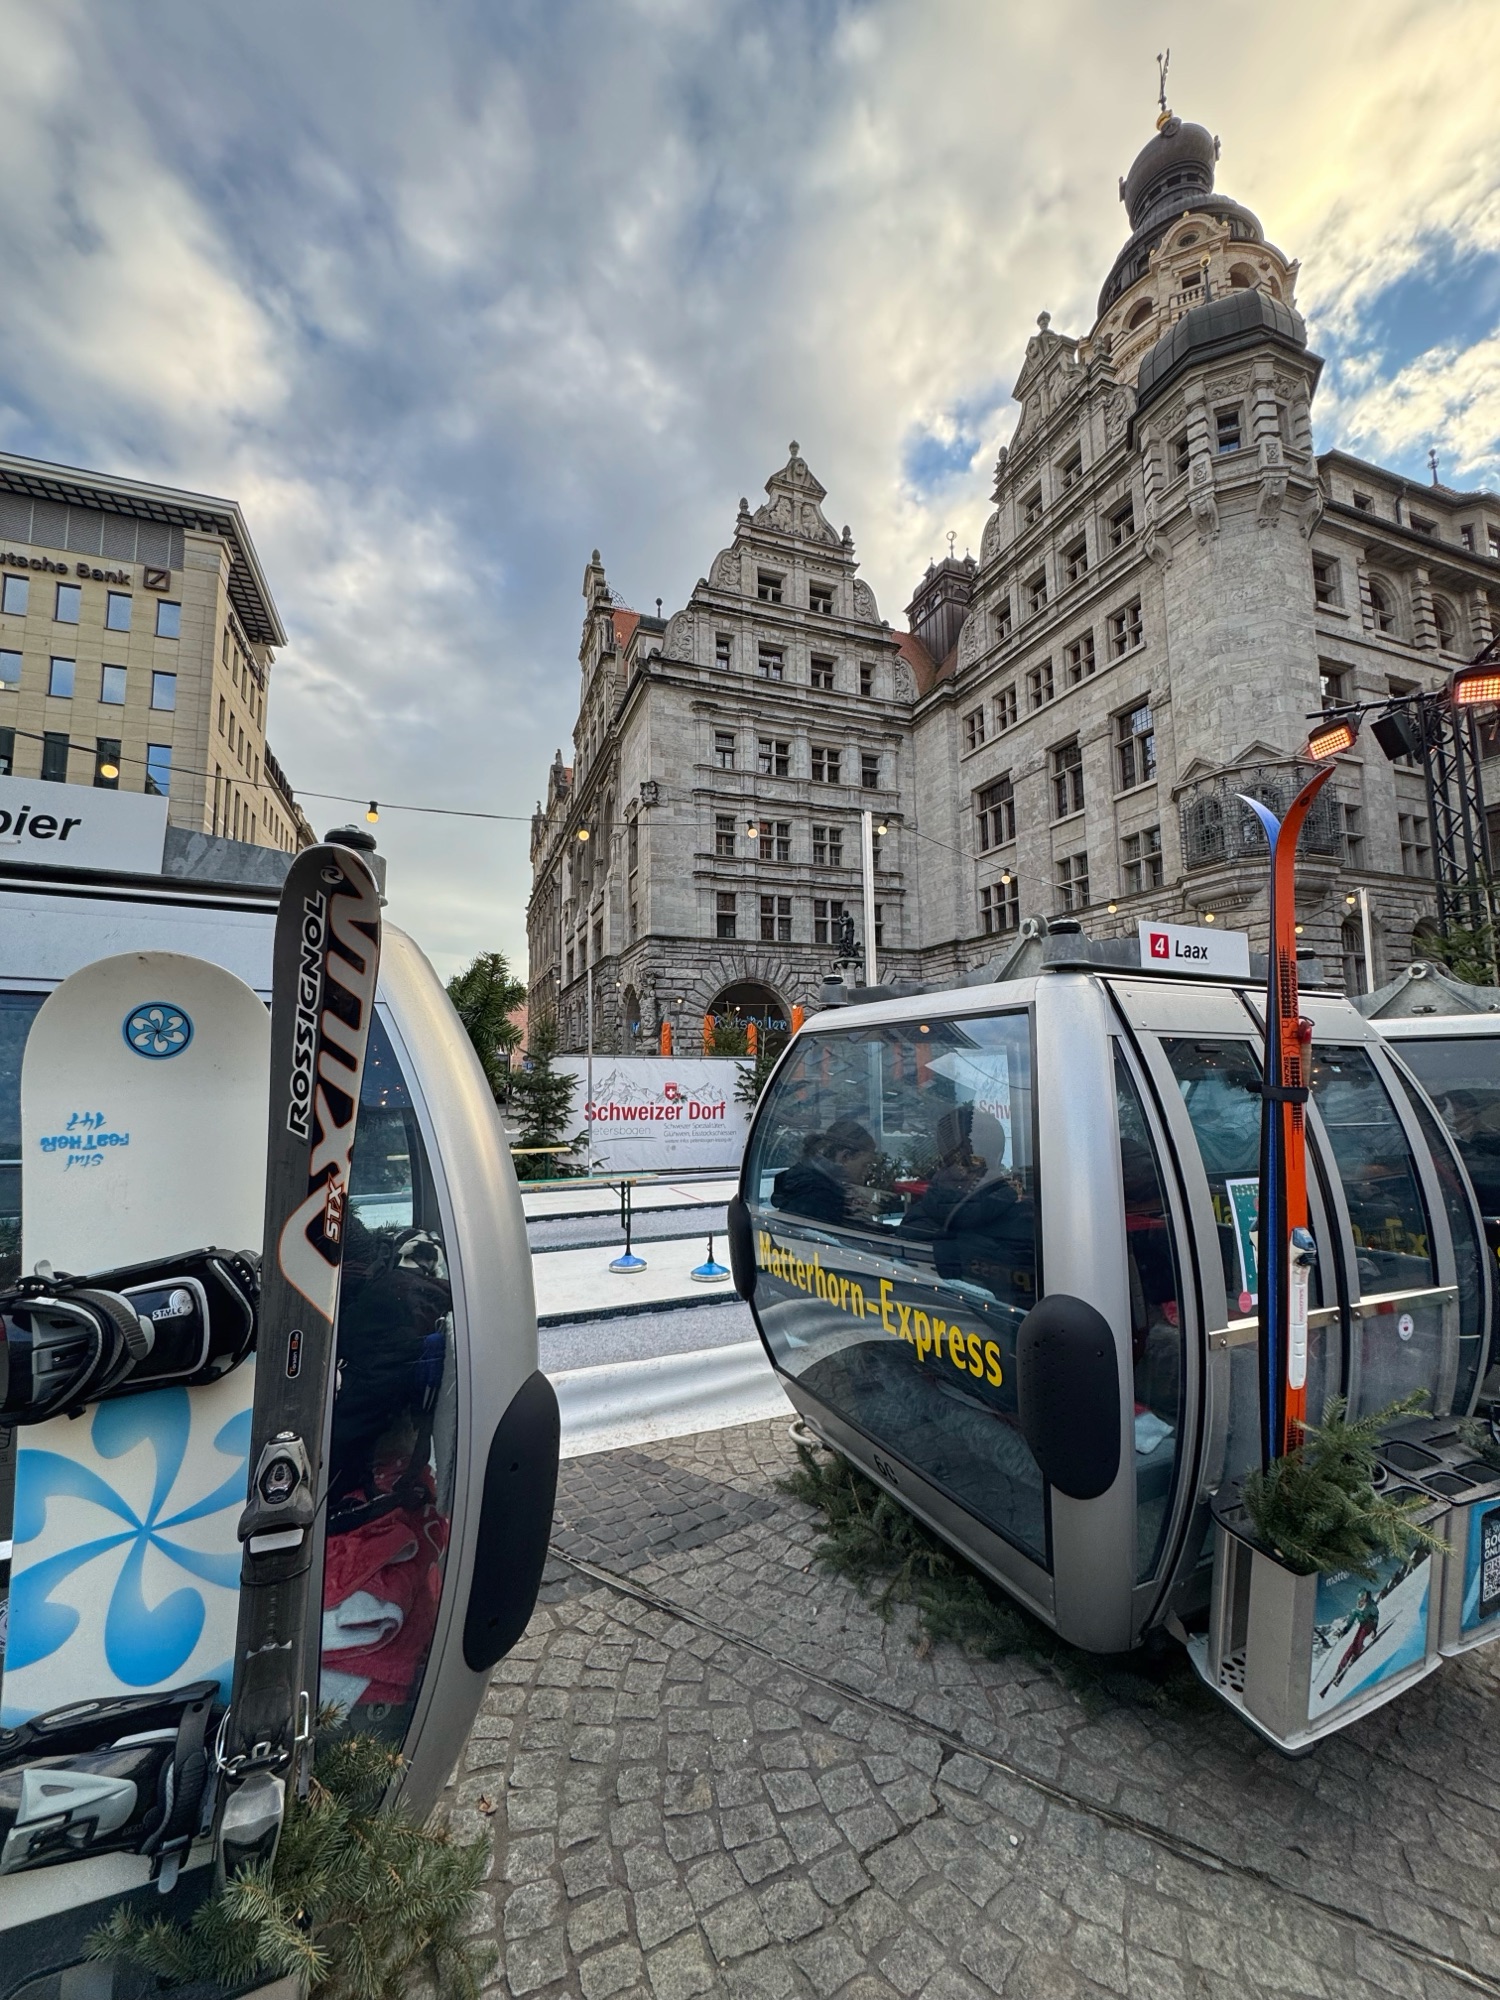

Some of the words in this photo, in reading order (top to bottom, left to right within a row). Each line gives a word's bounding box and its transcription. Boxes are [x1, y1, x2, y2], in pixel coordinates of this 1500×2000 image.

[76, 562, 131, 586] Bank
[1155, 937, 1165, 955] 4
[1175, 940, 1208, 960] Laax
[1290, 961, 1298, 1018] GERMINA
[286, 890, 327, 1140] ROSSIGNOL
[66, 1111, 107, 1131] 147
[584, 1102, 684, 1121] Schweizer
[688, 1101, 726, 1120] Dorf
[592, 1125, 651, 1137] etersbogen
[324, 1173, 344, 1243] STX
[759, 1230, 1003, 1387] Matterhorn-Express
